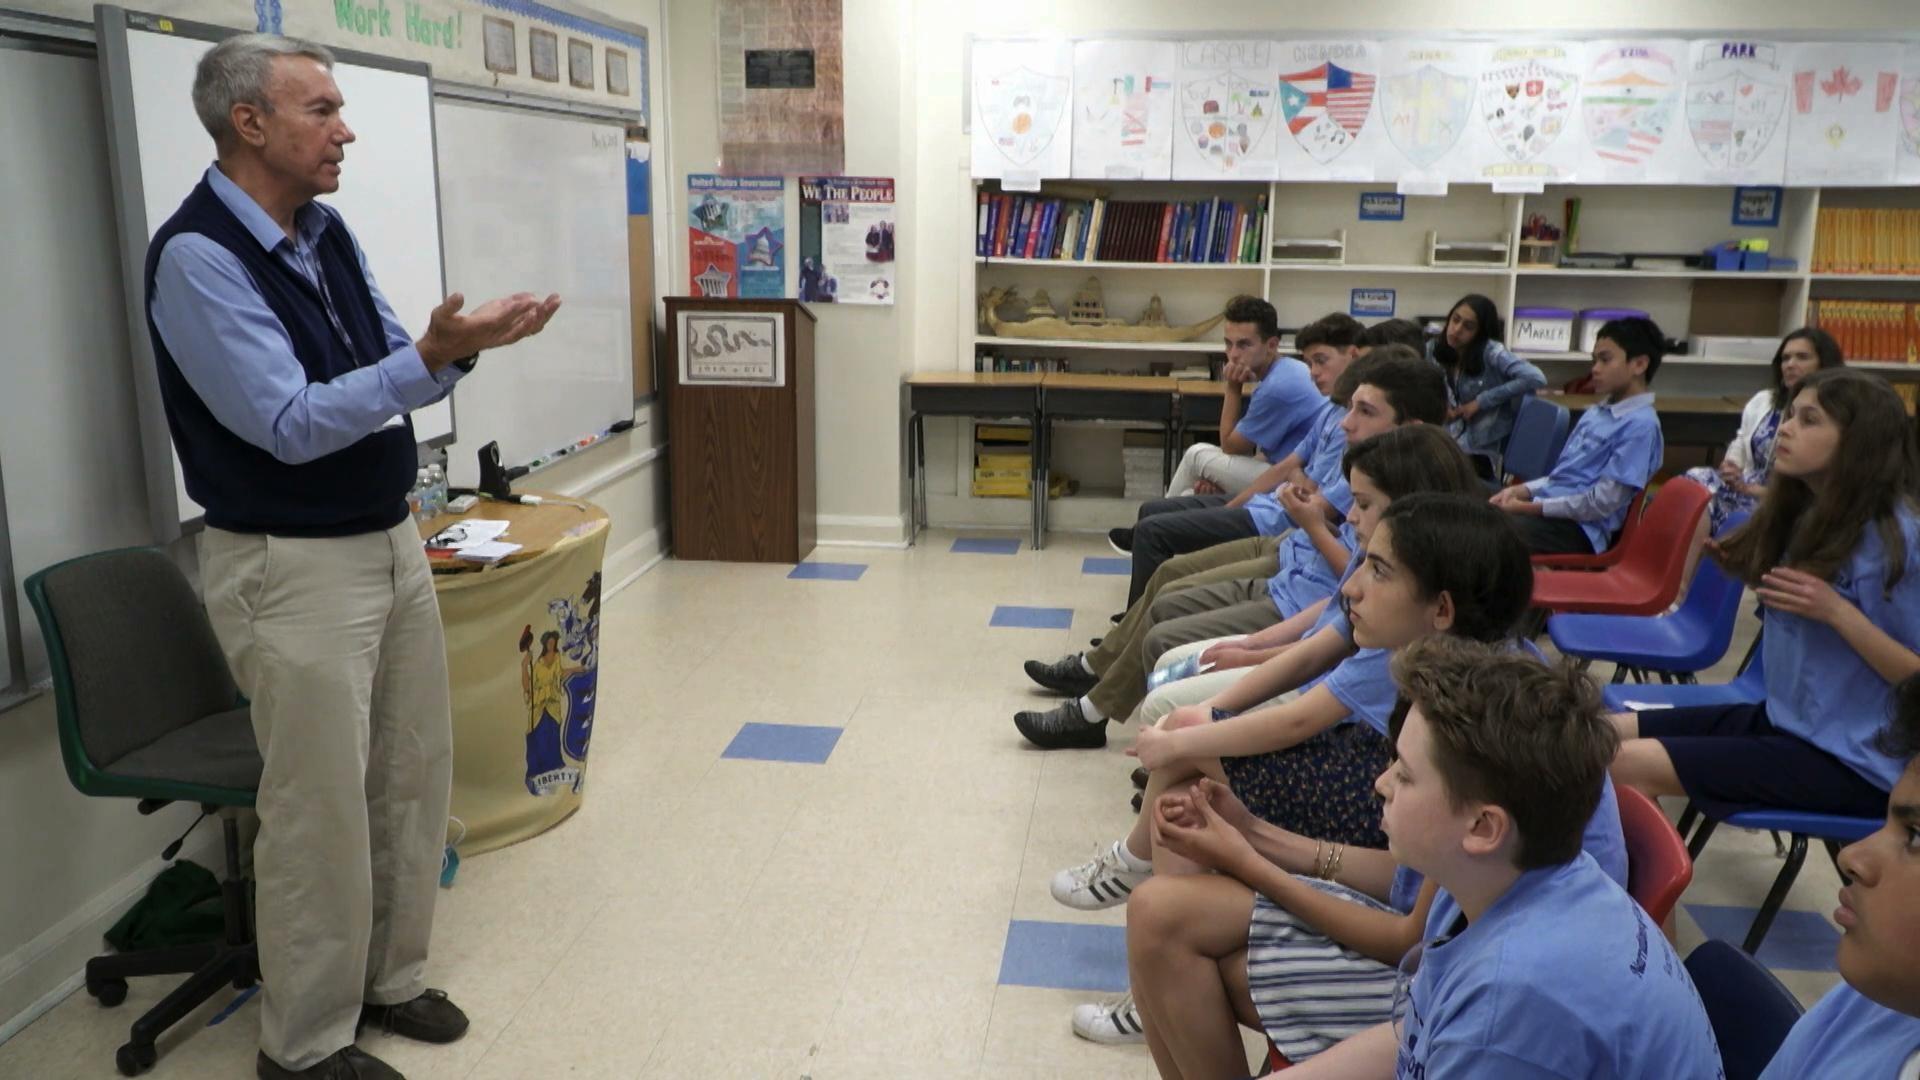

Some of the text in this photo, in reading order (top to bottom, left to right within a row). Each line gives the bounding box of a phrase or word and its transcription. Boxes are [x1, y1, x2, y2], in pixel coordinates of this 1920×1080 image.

[333, 0, 462, 48] Work Hard!
[1722, 43, 1757, 59] PARK
[824, 185, 848, 200] THE
[851, 187, 893, 201] PEOPLE
